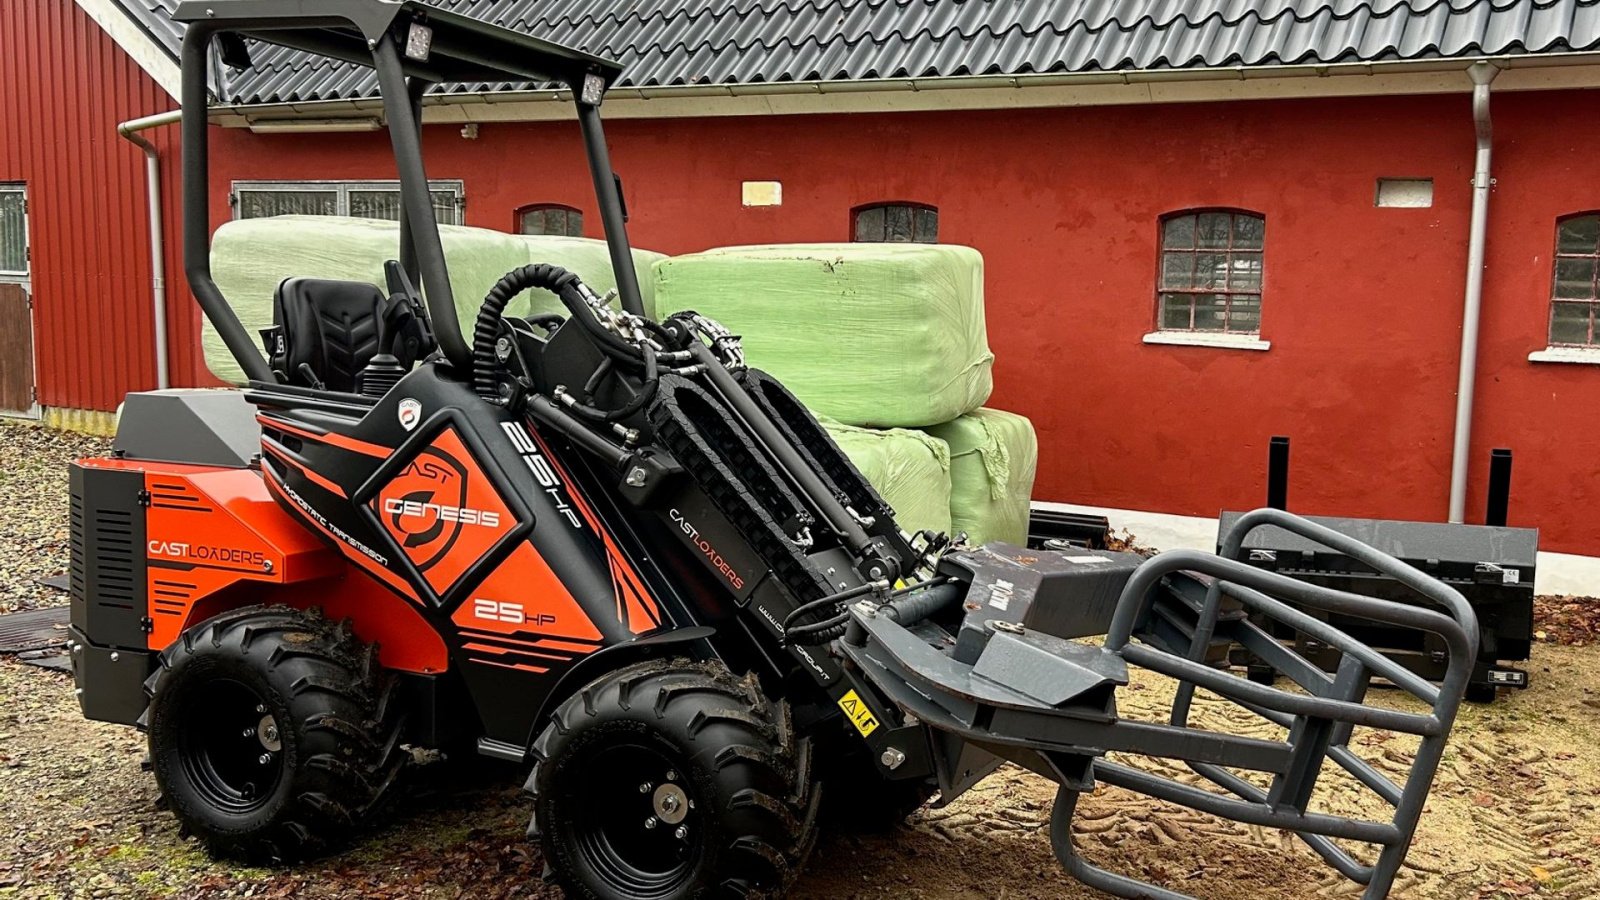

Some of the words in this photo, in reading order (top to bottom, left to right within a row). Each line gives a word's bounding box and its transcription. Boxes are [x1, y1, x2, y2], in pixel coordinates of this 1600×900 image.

[395, 461, 454, 485] AST
[384, 498, 500, 528] GENESIS
[148, 539, 264, 565] CASTLOADERS
[328, 522, 388, 566] TRANSMISSION
[669, 508, 744, 590] CASTLOADERS
